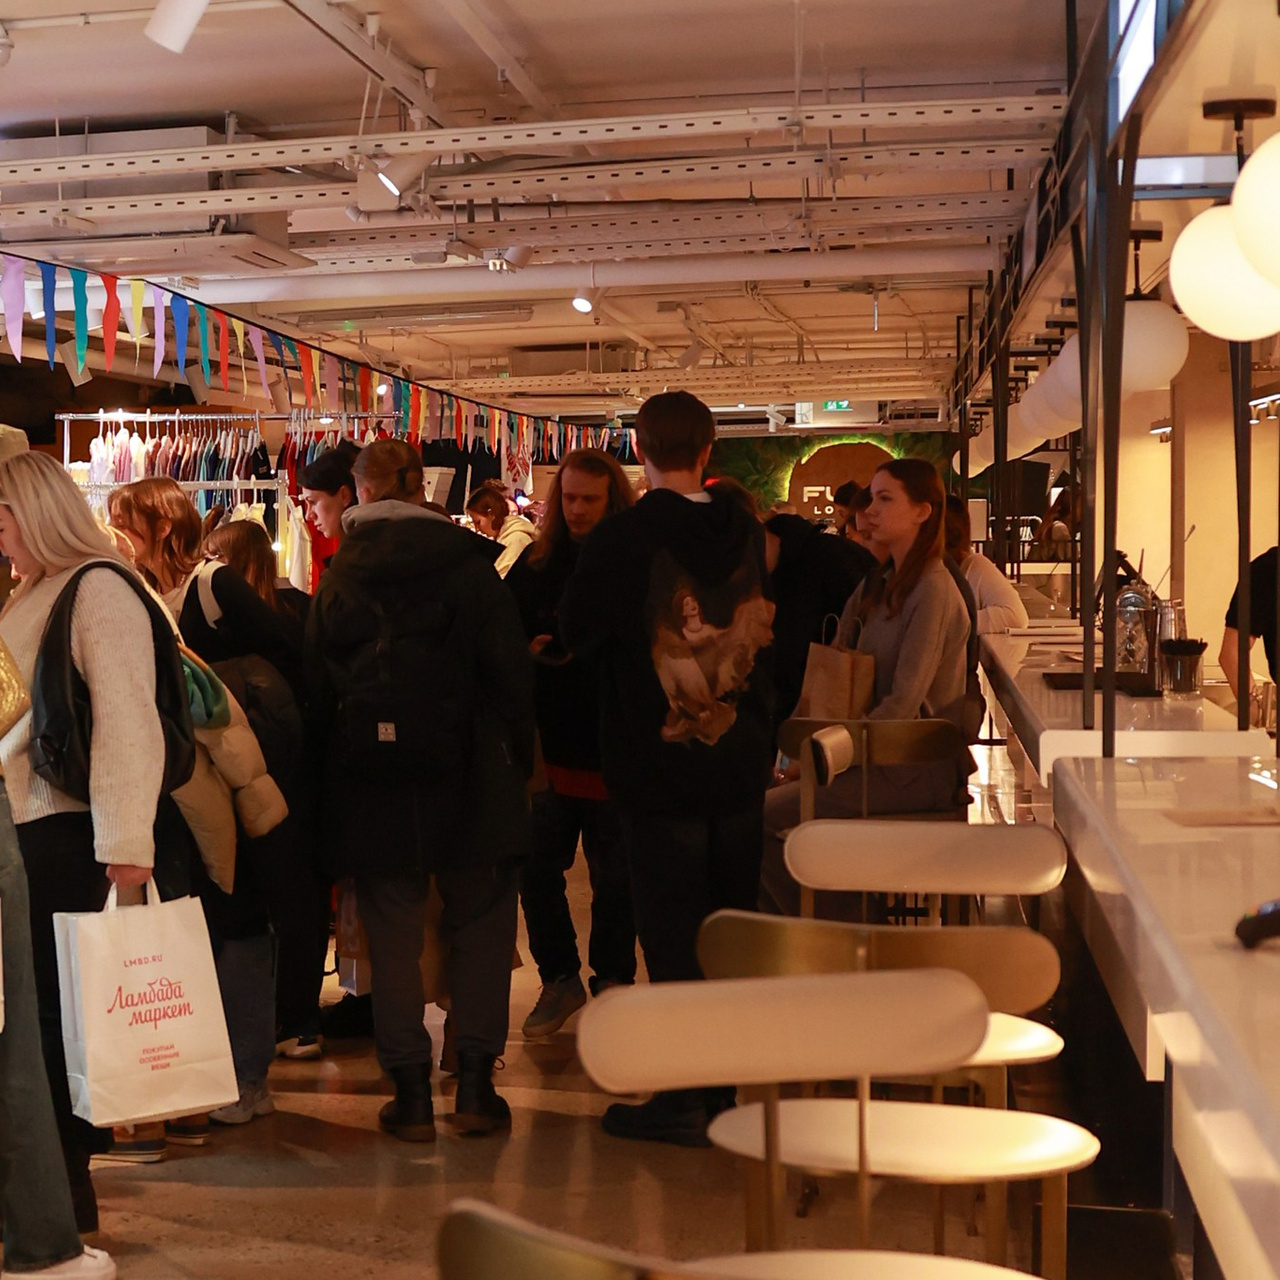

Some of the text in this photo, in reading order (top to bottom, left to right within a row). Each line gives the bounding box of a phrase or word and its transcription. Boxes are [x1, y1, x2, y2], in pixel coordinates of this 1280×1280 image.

[123, 954, 164, 968] LMBD.RU
[107, 976, 185, 1014] Ламбада
[128, 1001, 194, 1031] маркет
